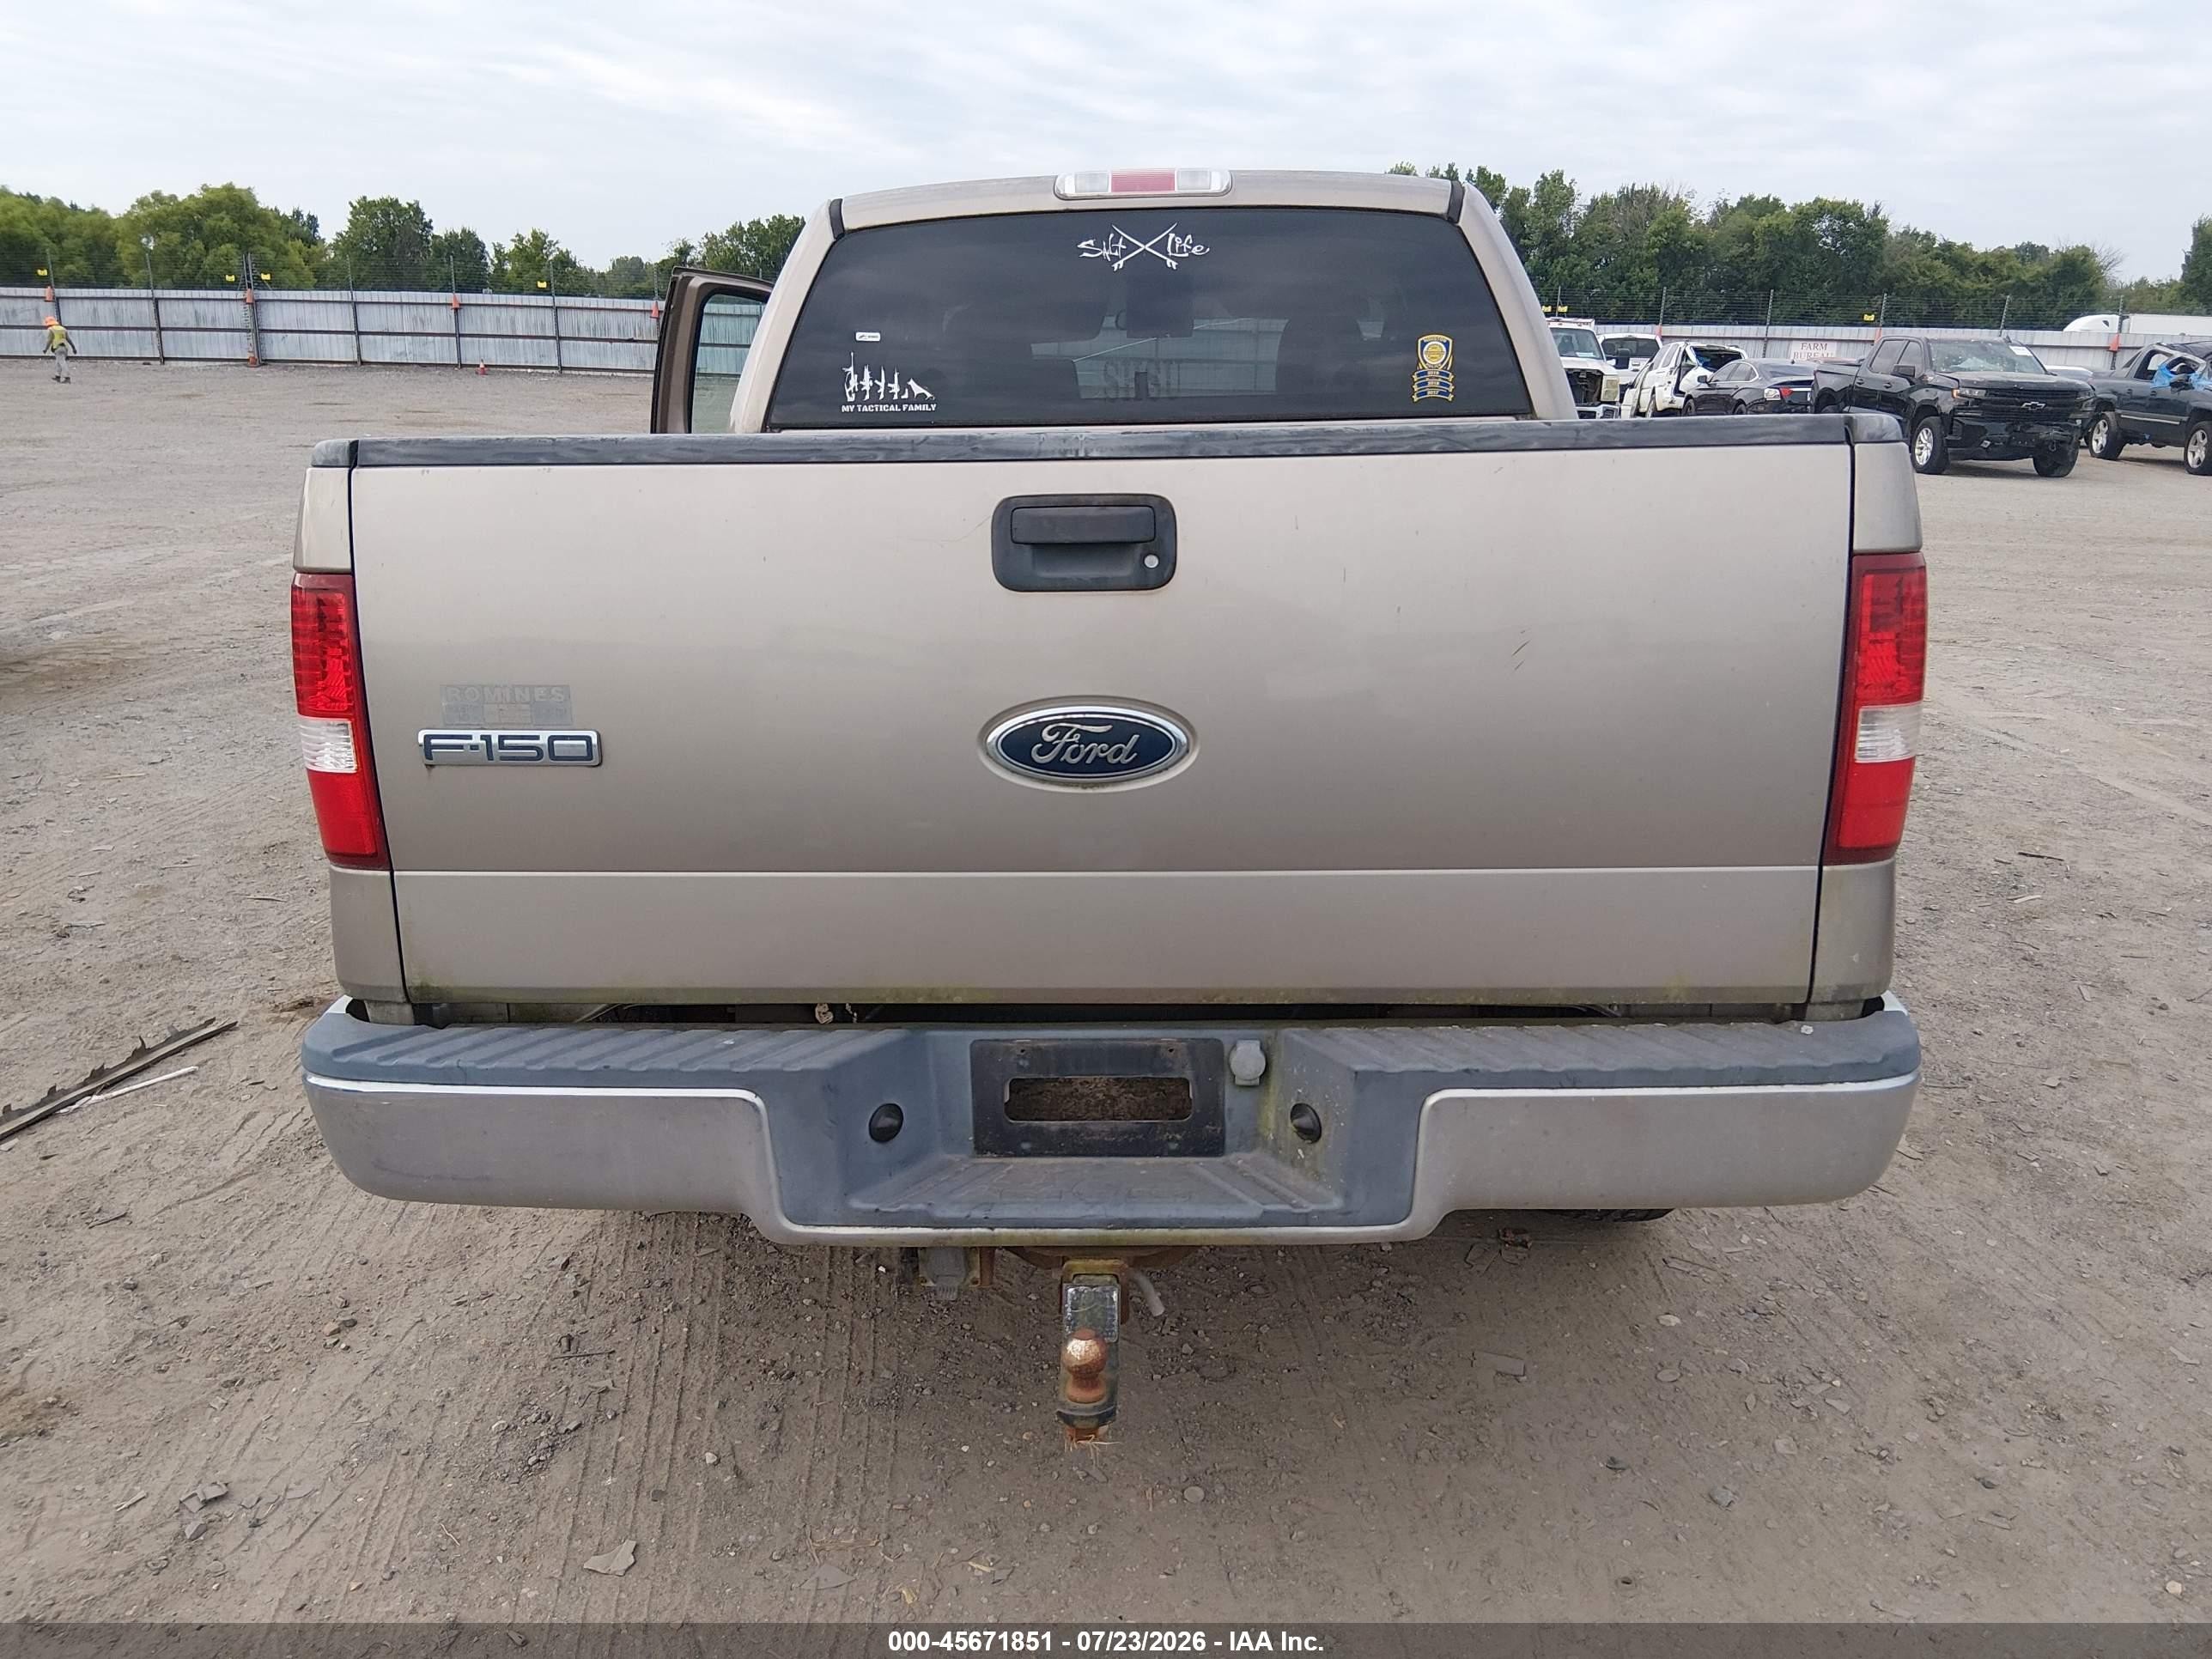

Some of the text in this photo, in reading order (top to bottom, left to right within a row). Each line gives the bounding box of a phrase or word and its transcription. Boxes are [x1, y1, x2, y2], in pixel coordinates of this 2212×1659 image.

[1167, 233, 1210, 258] Life
[841, 404, 855, 413] MY
[857, 404, 901, 412] TACTICAL
[446, 686, 566, 702] ROMINES
[423, 733, 594, 762] F-150
[1030, 721, 1140, 765] Ford
